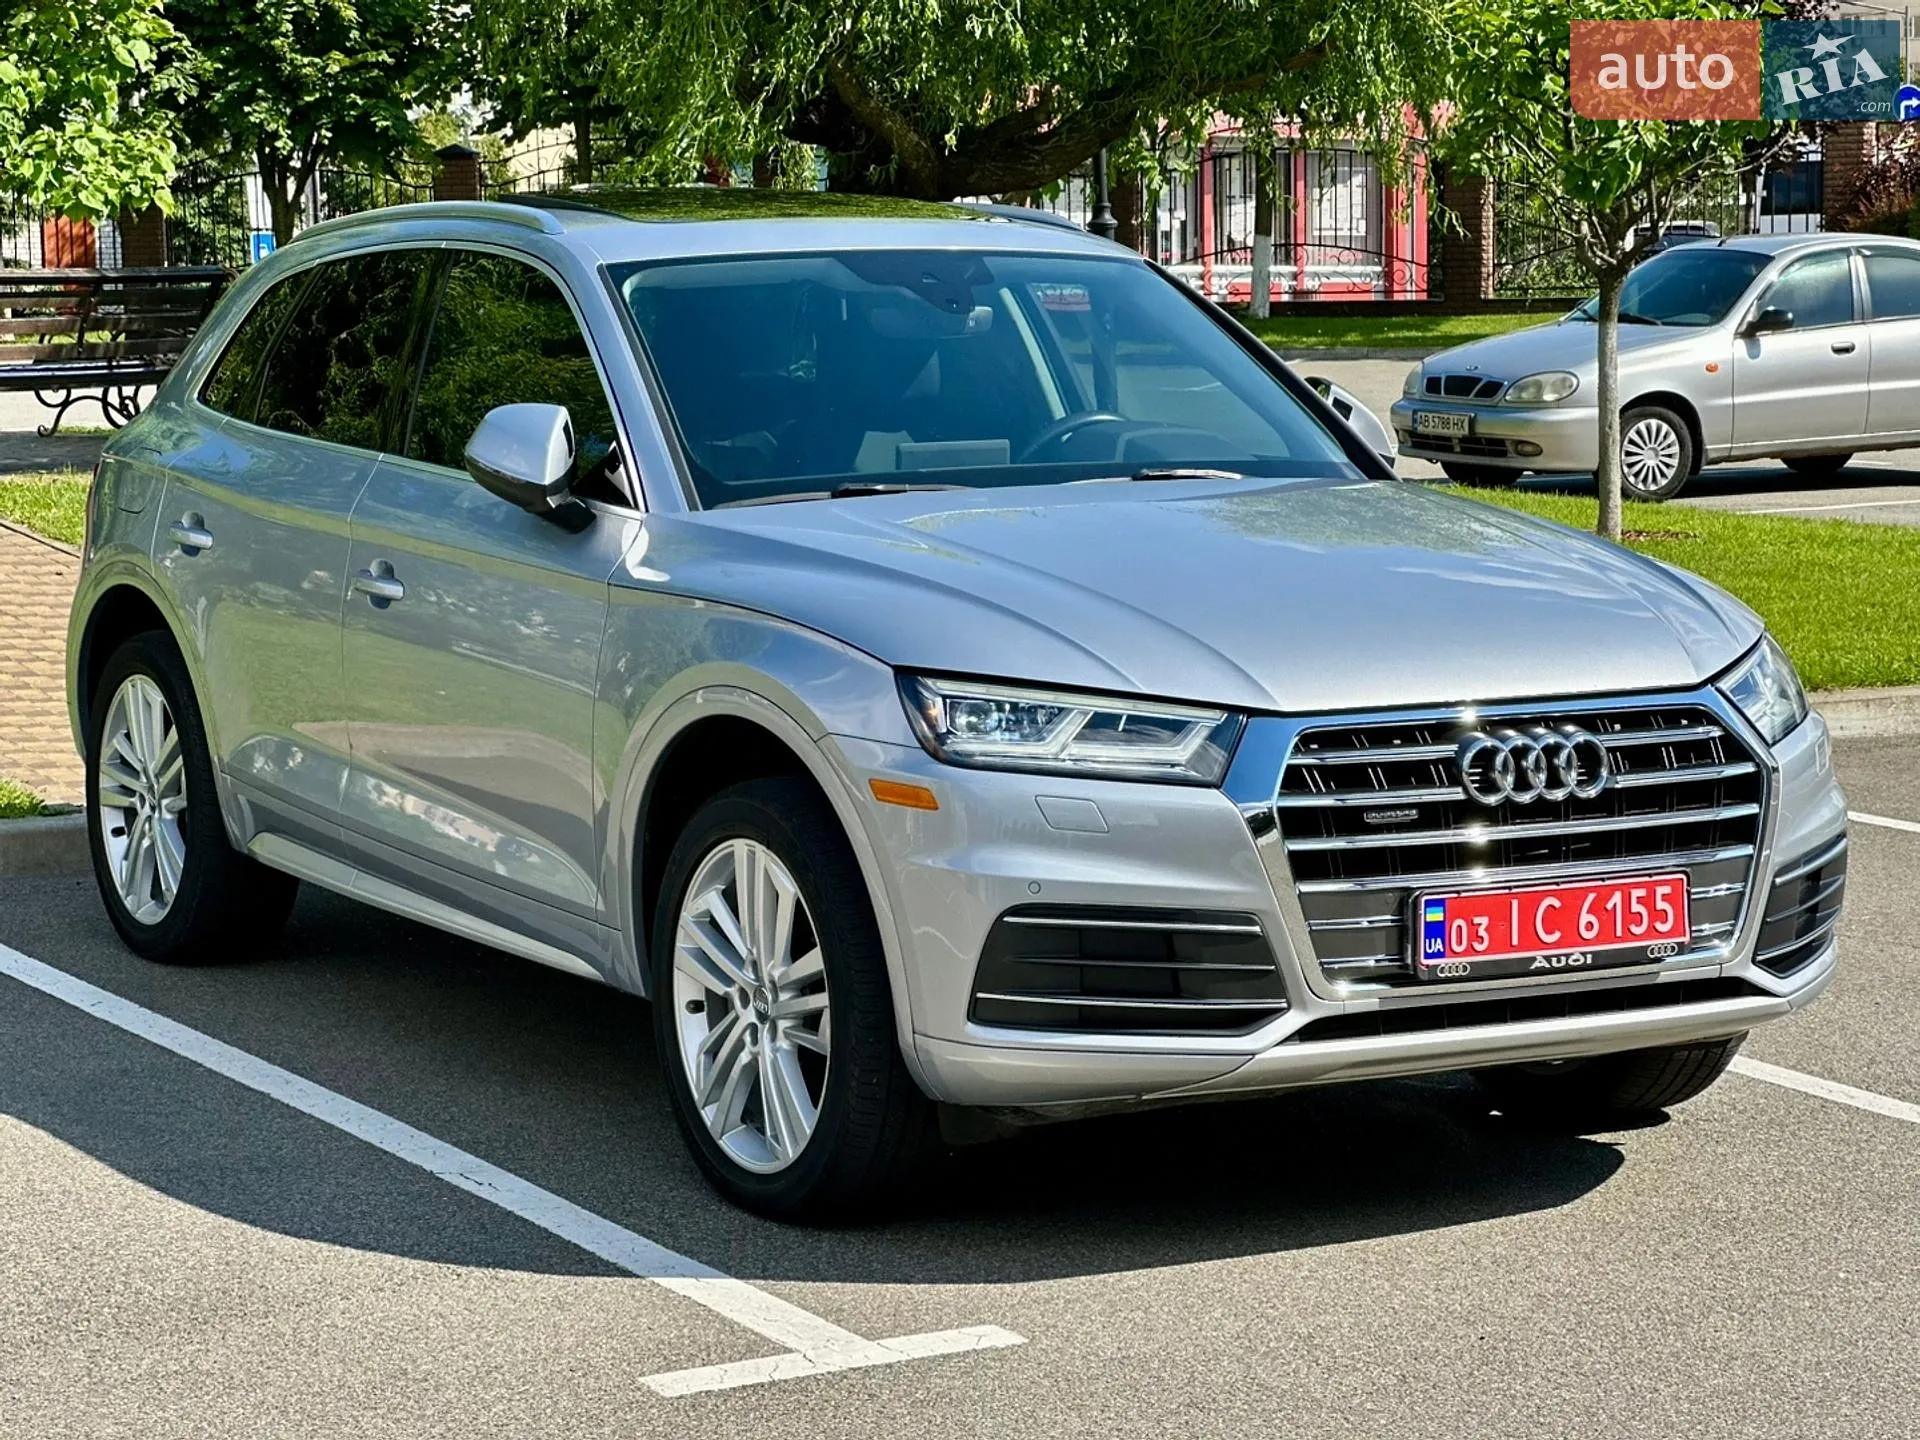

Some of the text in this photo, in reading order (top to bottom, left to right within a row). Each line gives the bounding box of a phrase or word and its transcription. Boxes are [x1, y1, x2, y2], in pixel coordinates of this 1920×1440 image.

[1419, 414, 1466, 432] AB 5788 HX
[1450, 916, 1490, 953] 03
[1578, 885, 1675, 940] 6155
[1425, 938, 1444, 954] UA
